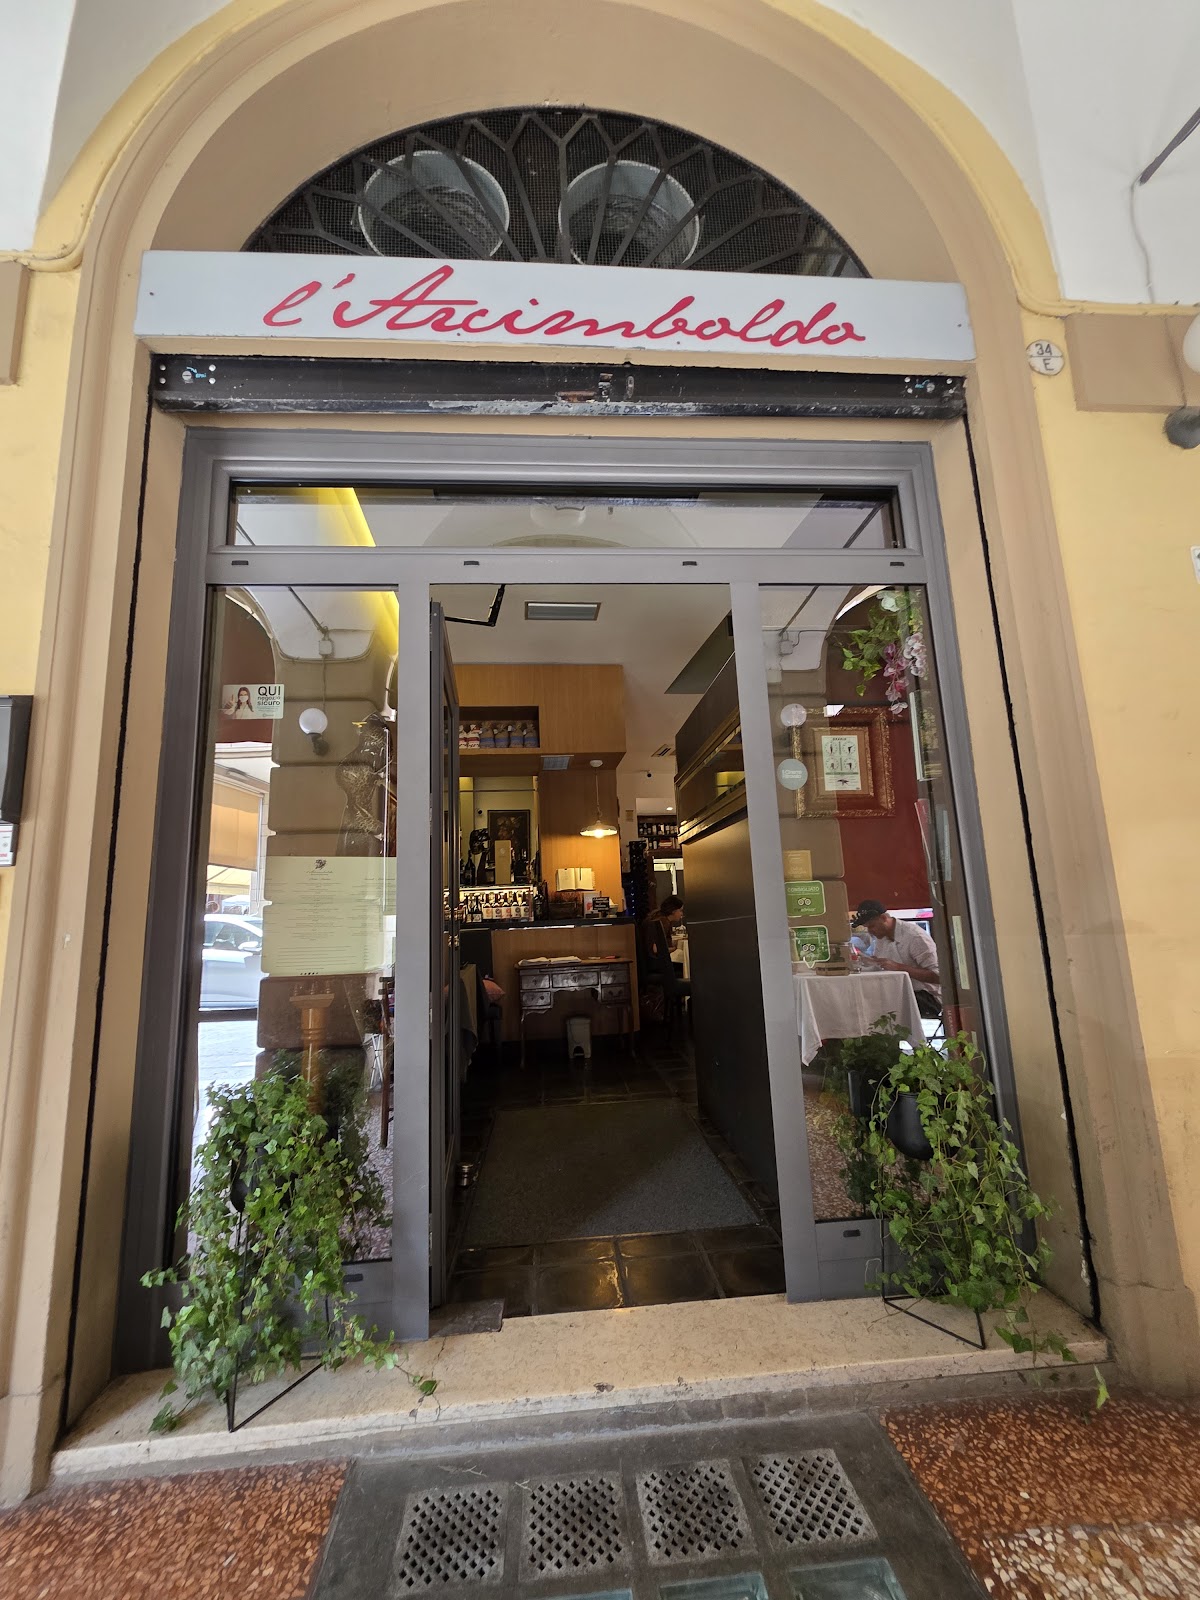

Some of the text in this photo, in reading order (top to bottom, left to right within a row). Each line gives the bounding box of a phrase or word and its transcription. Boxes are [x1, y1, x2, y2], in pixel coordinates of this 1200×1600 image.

[264, 266, 864, 347] l'Arcimboldo
[1035, 343, 1053, 356] 34
[1043, 358, 1055, 371] E
[257, 686, 281, 696] QUI
